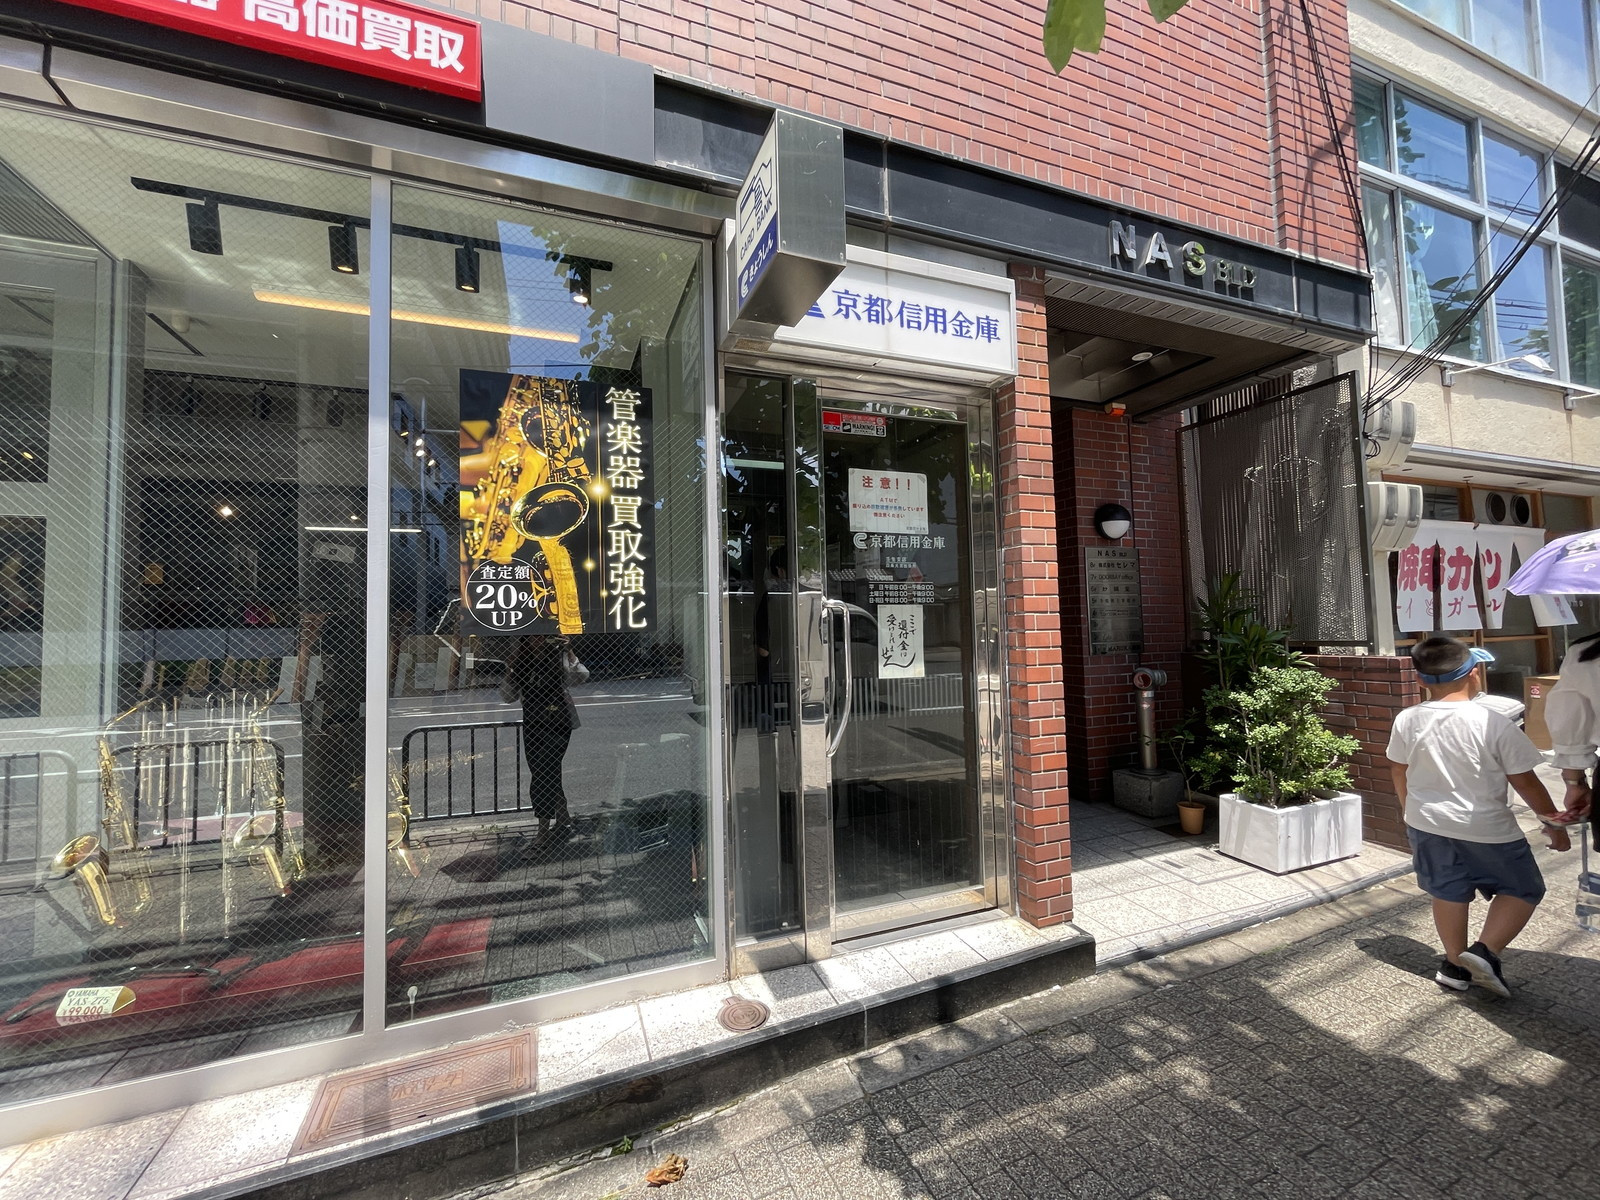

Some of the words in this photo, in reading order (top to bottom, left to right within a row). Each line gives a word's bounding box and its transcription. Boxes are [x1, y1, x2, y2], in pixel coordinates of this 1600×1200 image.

[244, 0, 465, 73] 高価買取
[740, 228, 754, 260] CARD
[757, 193, 773, 231] BANK
[1109, 219, 1207, 277] NAS
[832, 289, 1001, 344] 京都信用金庫
[604, 386, 648, 630] 管楽器買取強化
[870, 535, 946, 550] 京都信用金庫
[480, 564, 531, 581] 査定額
[475, 584, 538, 610] 20%
[491, 611, 523, 626] UP
[74, 989, 100, 997] YAMAHA
